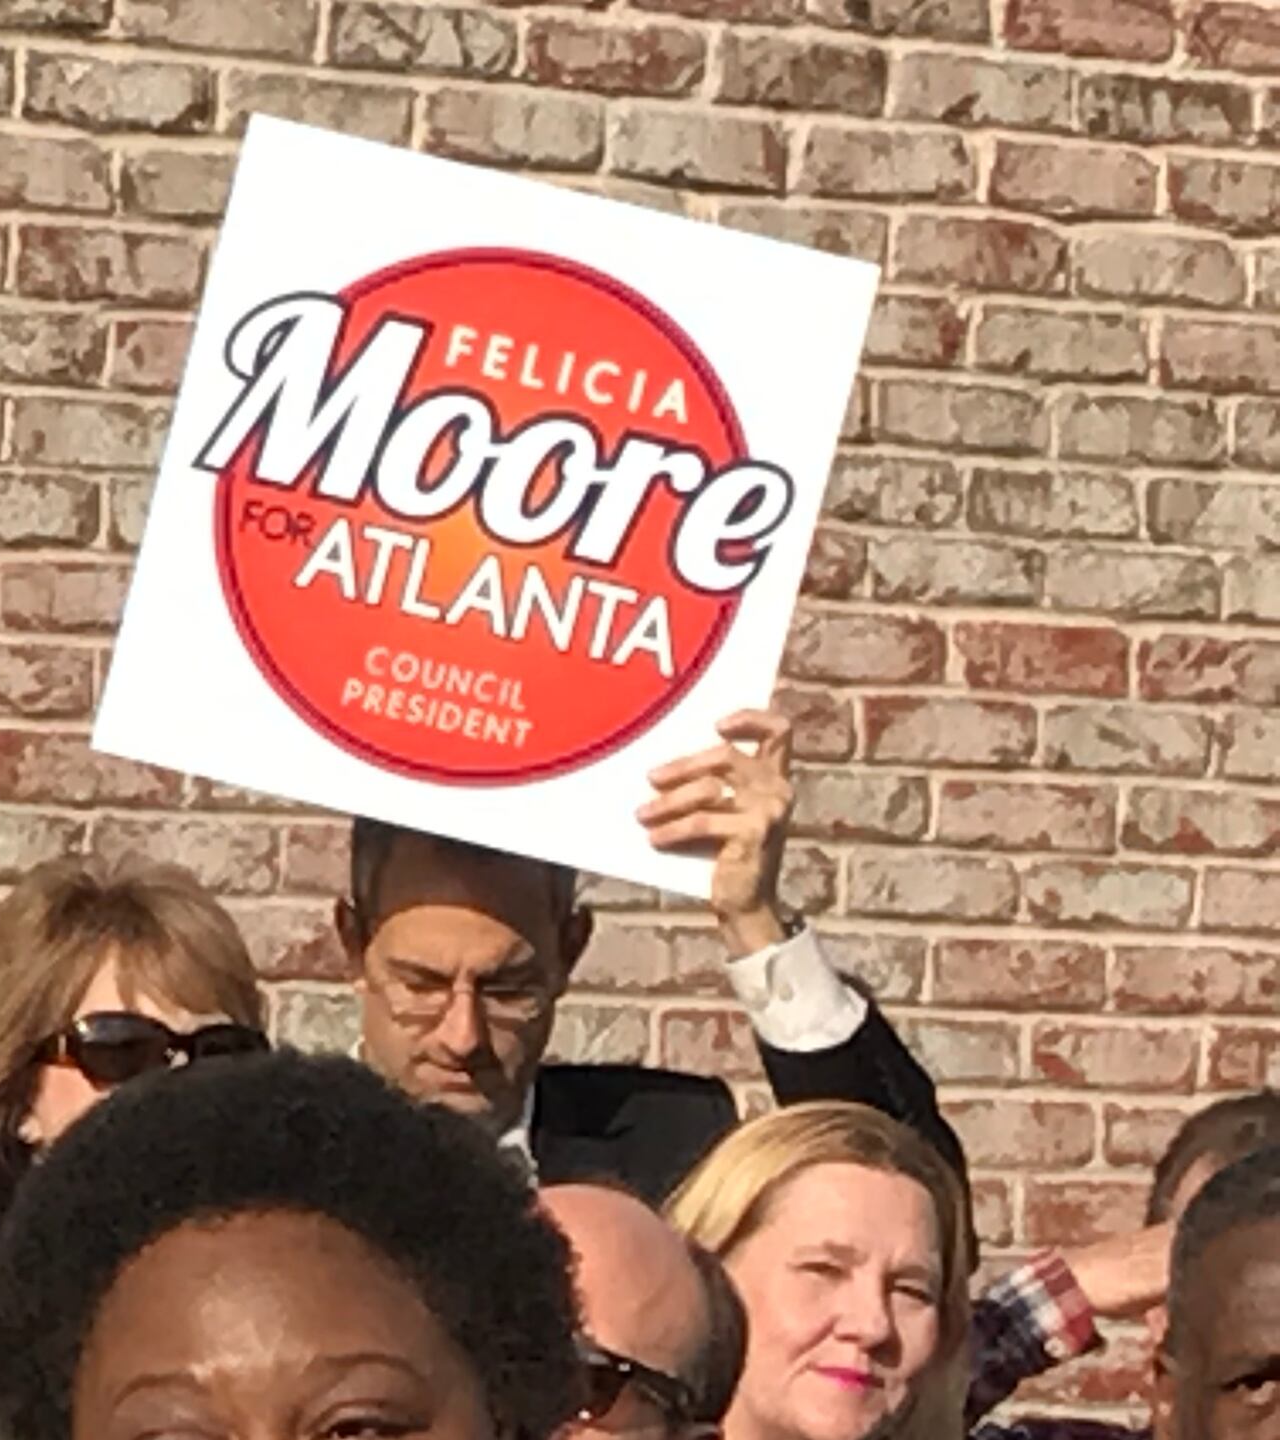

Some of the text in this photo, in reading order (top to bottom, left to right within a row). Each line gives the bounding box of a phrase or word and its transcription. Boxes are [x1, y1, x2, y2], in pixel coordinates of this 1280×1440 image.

[444, 324, 689, 424] FELICIA
[193, 290, 795, 595] Moore
[239, 500, 676, 678] FOR ATLANTA
[341, 678, 534, 749] PRESIDENT
[364, 645, 525, 710] COUNCIL
